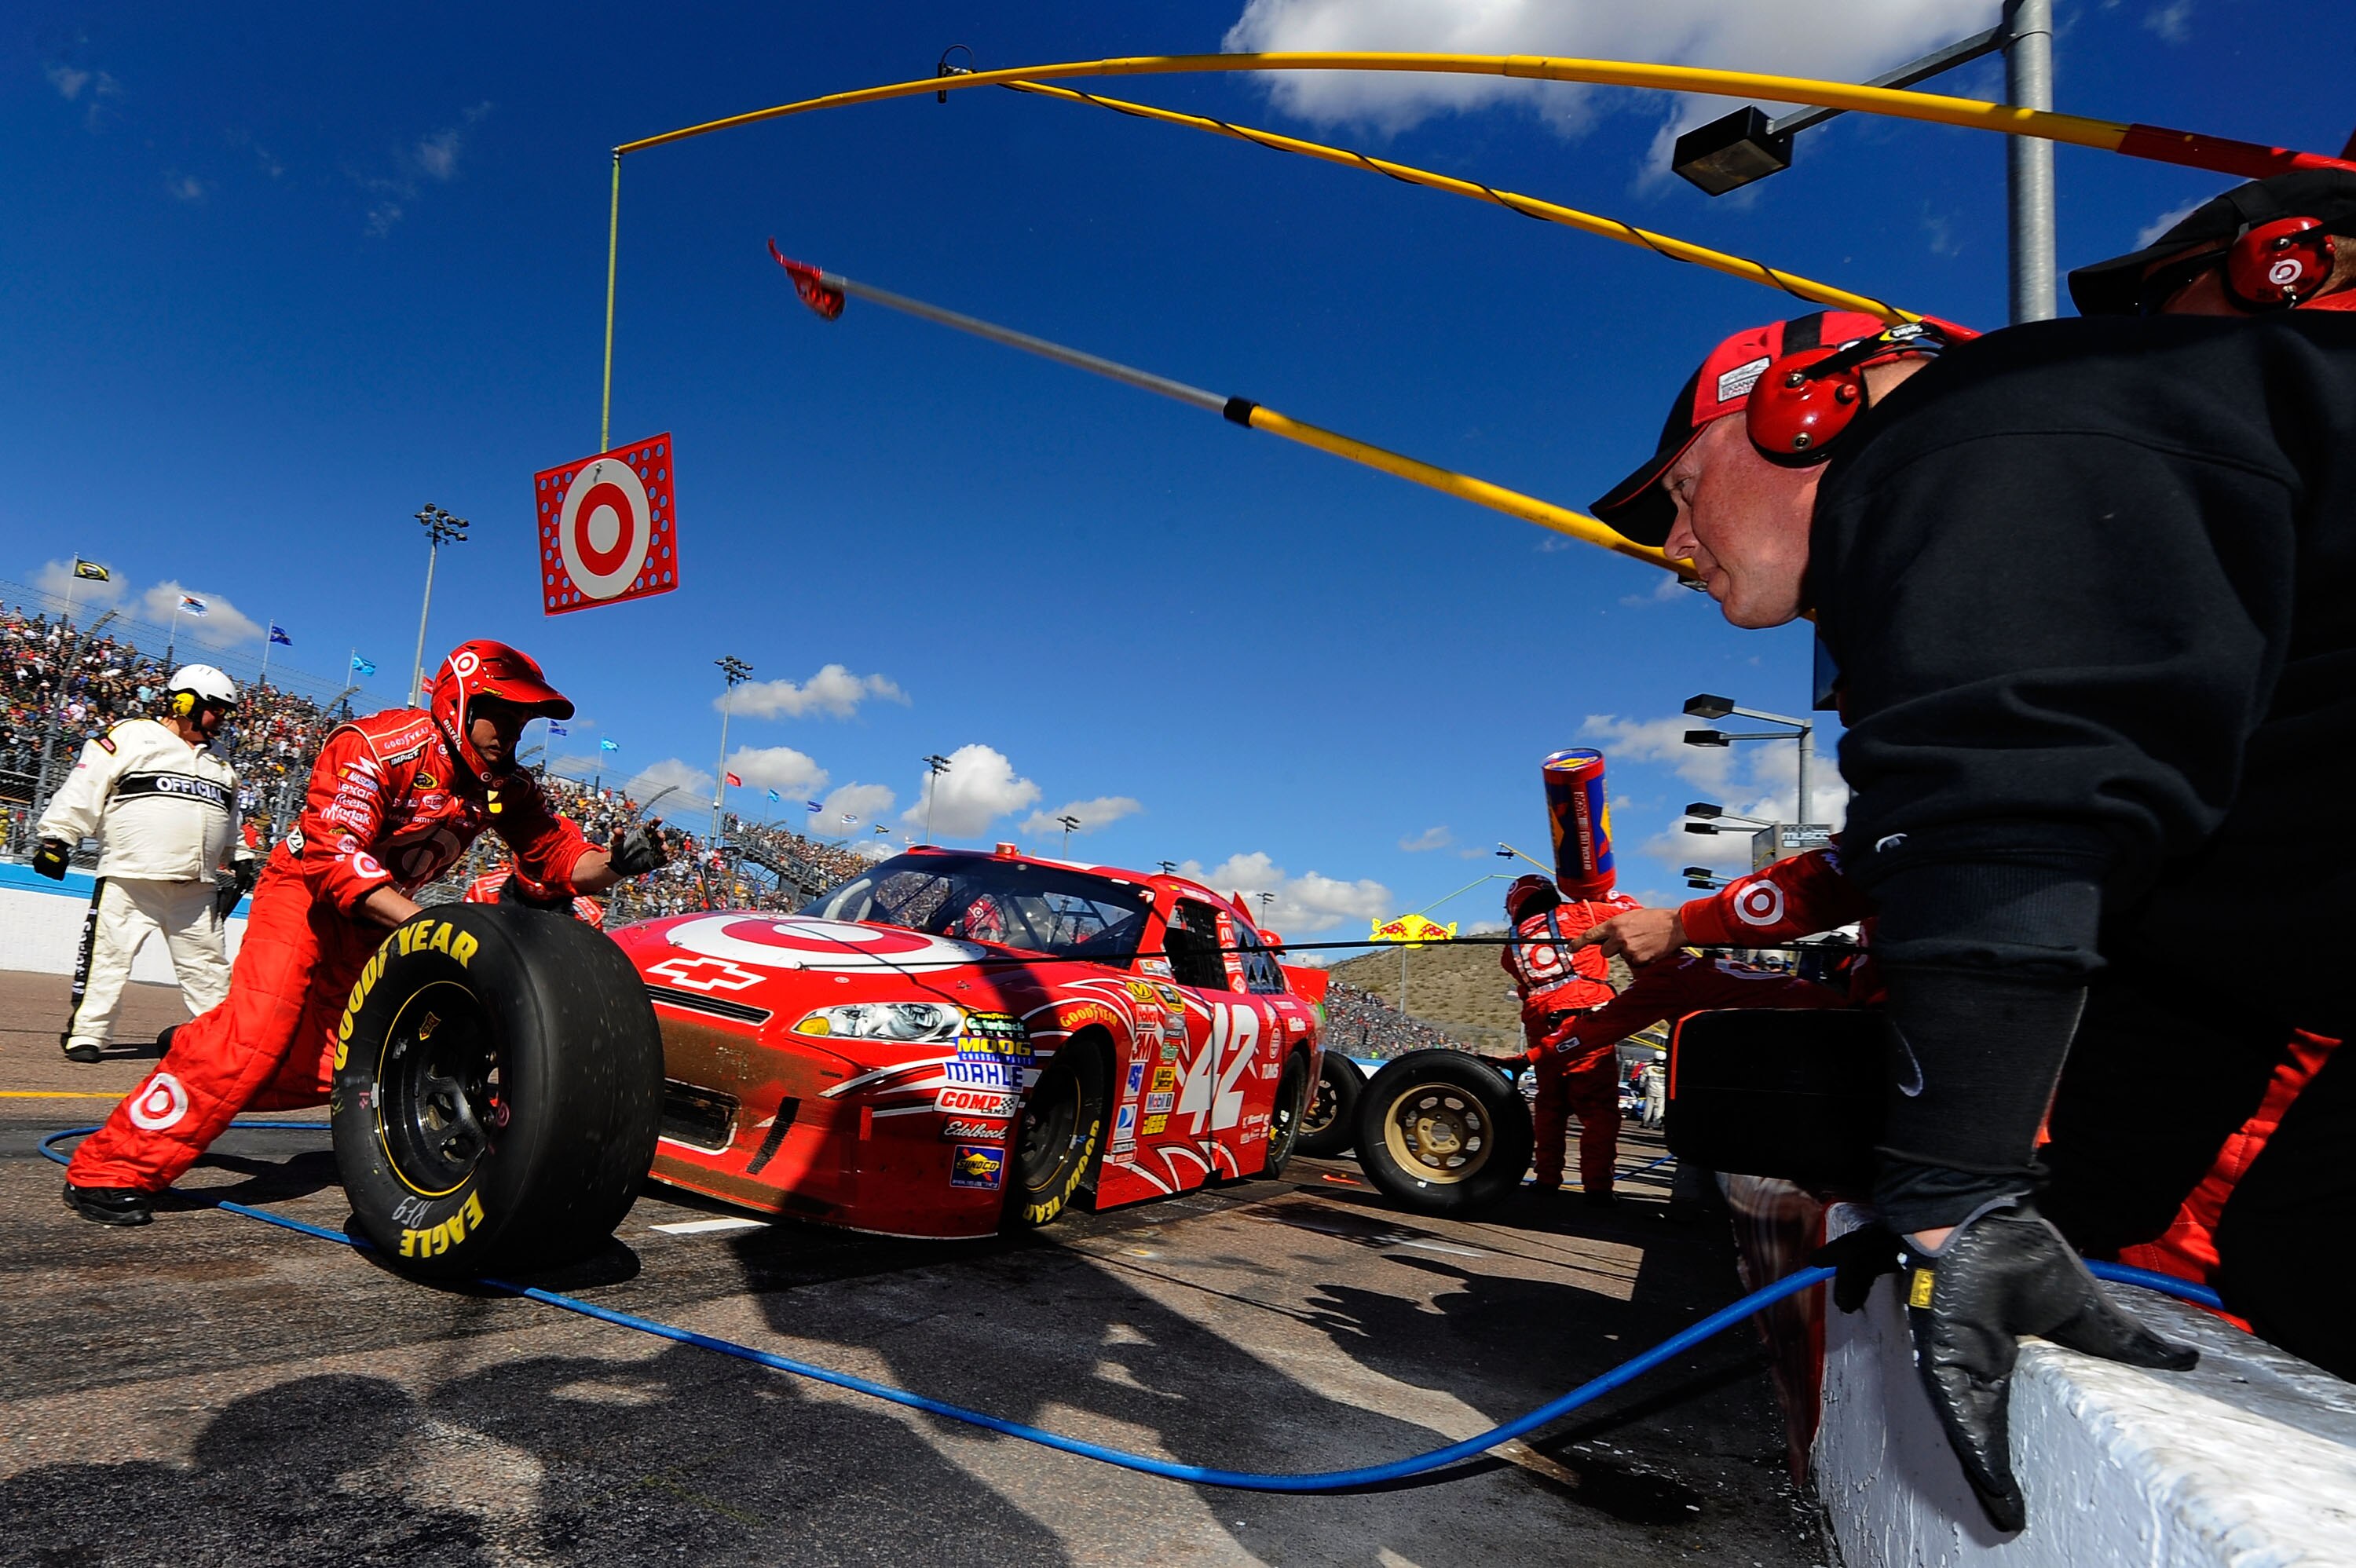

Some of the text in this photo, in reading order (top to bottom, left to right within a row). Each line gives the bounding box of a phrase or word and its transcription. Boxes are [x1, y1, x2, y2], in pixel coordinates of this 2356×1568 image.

[1891, 324, 1923, 337] Sprint
[391, 748, 419, 766] IMPACT
[156, 777, 225, 805] OFFICIAL
[330, 802, 371, 825] Kodak
[334, 919, 478, 1071] GOODYEAR
[966, 1017, 1025, 1032] Gatorback
[1060, 1003, 1118, 1028] GOODYEAR
[957, 1037, 1031, 1056] MOOG
[946, 1062, 1024, 1087] MAHLE
[1176, 1002, 1260, 1135] 42
[940, 1091, 1002, 1110] COMP
[944, 1120, 1008, 1140] Edelbrock
[958, 1160, 997, 1171] SUNOCO
[1023, 1120, 1100, 1224] GOODYEAR
[399, 1188, 485, 1258] EAGLE
